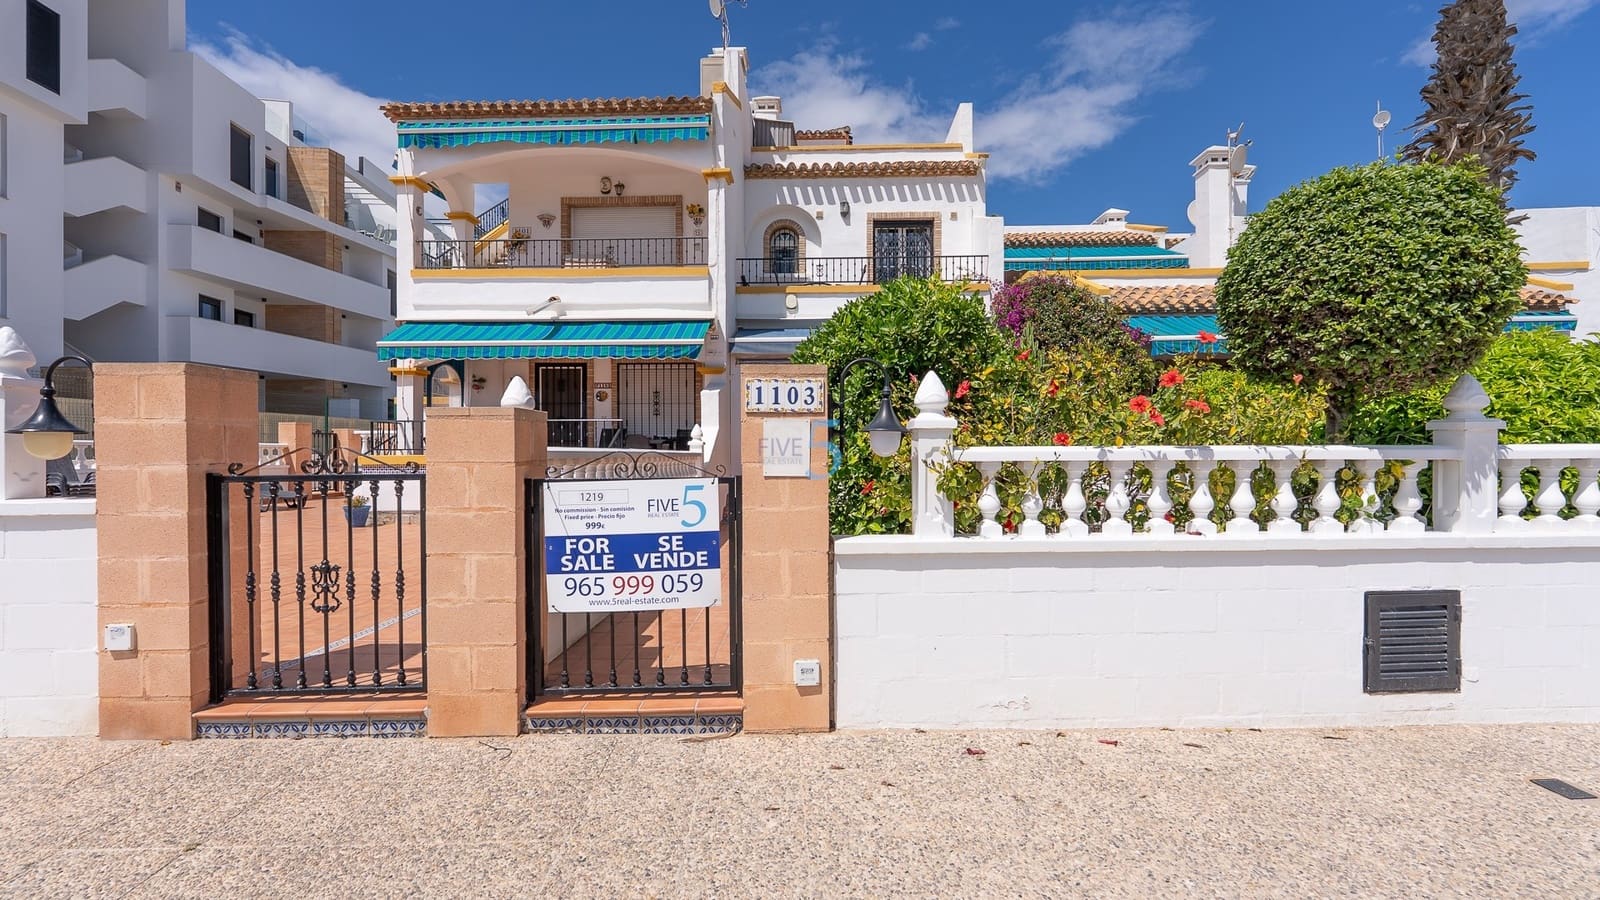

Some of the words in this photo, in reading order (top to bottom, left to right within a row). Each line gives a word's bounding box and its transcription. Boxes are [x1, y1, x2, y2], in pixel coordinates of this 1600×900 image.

[755, 386, 815, 405] 1103
[580, 492, 604, 502] 1219
[647, 498, 680, 512] FIVE
[681, 484, 707, 527] 5
[565, 537, 610, 555] FOR
[658, 535, 684, 552] SE
[560, 554, 615, 572] SALE
[633, 550, 709, 569] VENDE
[564, 576, 605, 597] 965
[612, 574, 655, 596] 999
[661, 572, 703, 594] 059
[588, 596, 680, 606] www.5real-estate.com
